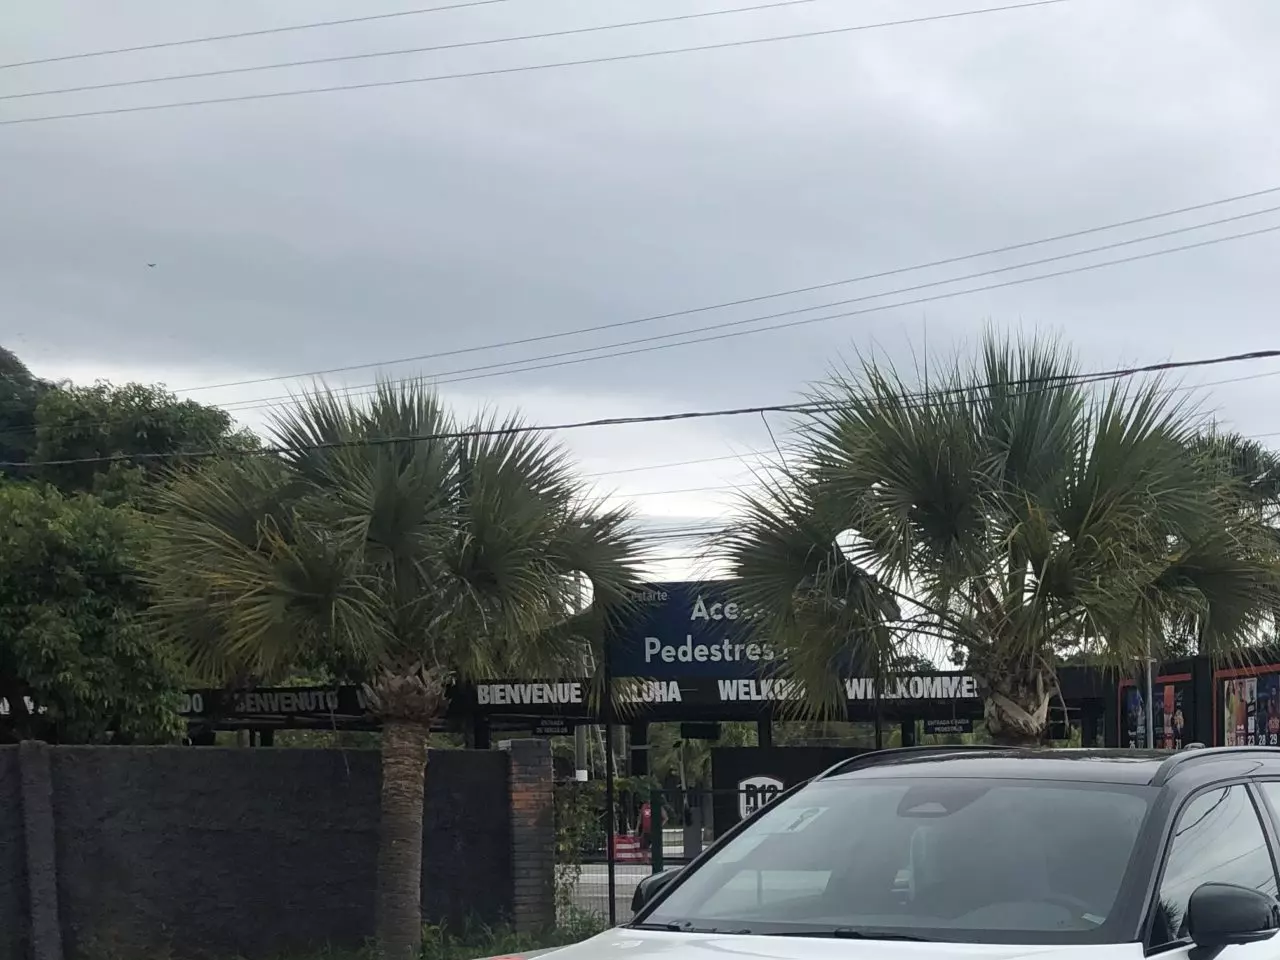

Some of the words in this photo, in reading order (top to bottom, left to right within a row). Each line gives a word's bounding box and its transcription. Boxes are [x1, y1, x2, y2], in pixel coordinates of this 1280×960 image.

[690, 597, 776, 620] Ace
[645, 635, 774, 662] Pedestres
[478, 683, 582, 705] BIENVENUE
[718, 679, 805, 701] WELKO
[845, 676, 978, 699] WILKOMME
